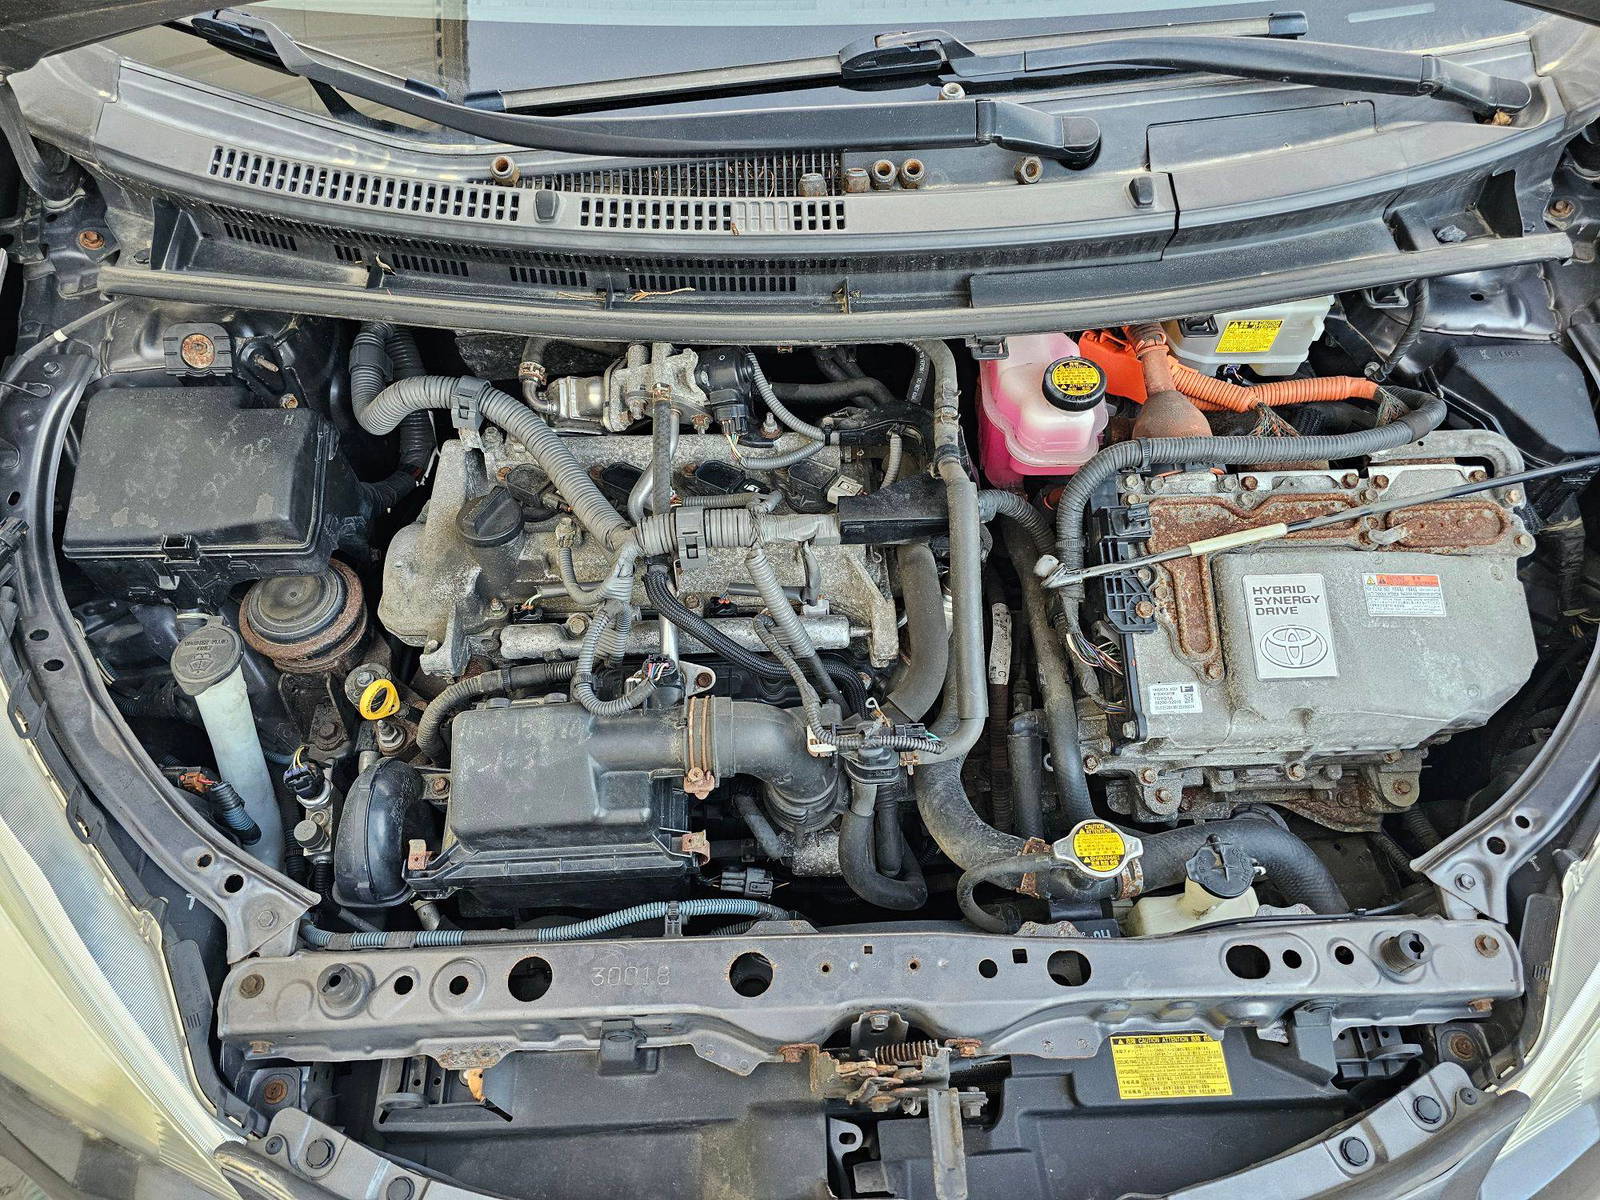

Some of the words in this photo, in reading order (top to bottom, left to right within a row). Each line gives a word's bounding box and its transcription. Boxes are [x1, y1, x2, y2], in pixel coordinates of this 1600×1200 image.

[1252, 585, 1306, 595] HYBRID
[1253, 595, 1320, 606] SYNERGY
[1255, 606, 1299, 616] DRIVE
